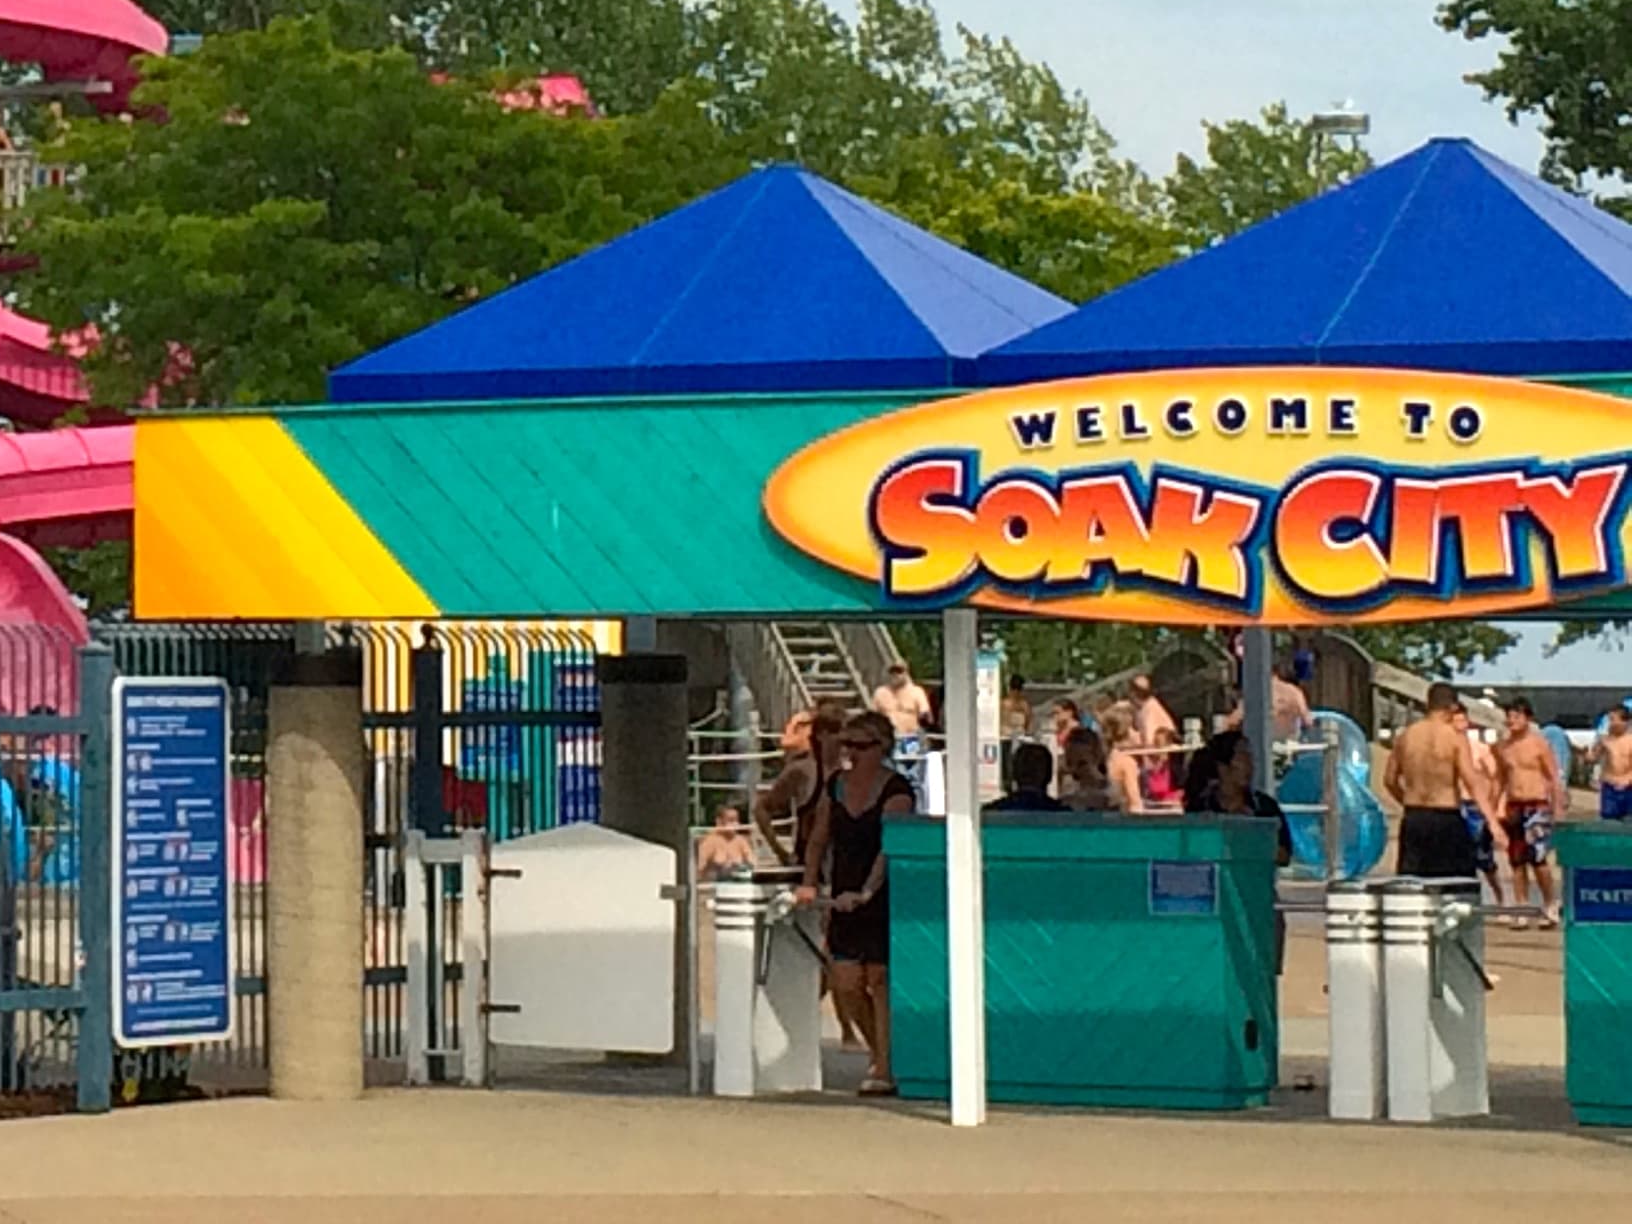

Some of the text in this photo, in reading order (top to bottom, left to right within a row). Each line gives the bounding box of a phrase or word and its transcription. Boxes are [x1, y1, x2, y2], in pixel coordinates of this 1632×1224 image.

[1011, 398, 1481, 447] WELCOME TO
[873, 456, 1628, 604] SOAK CITY
